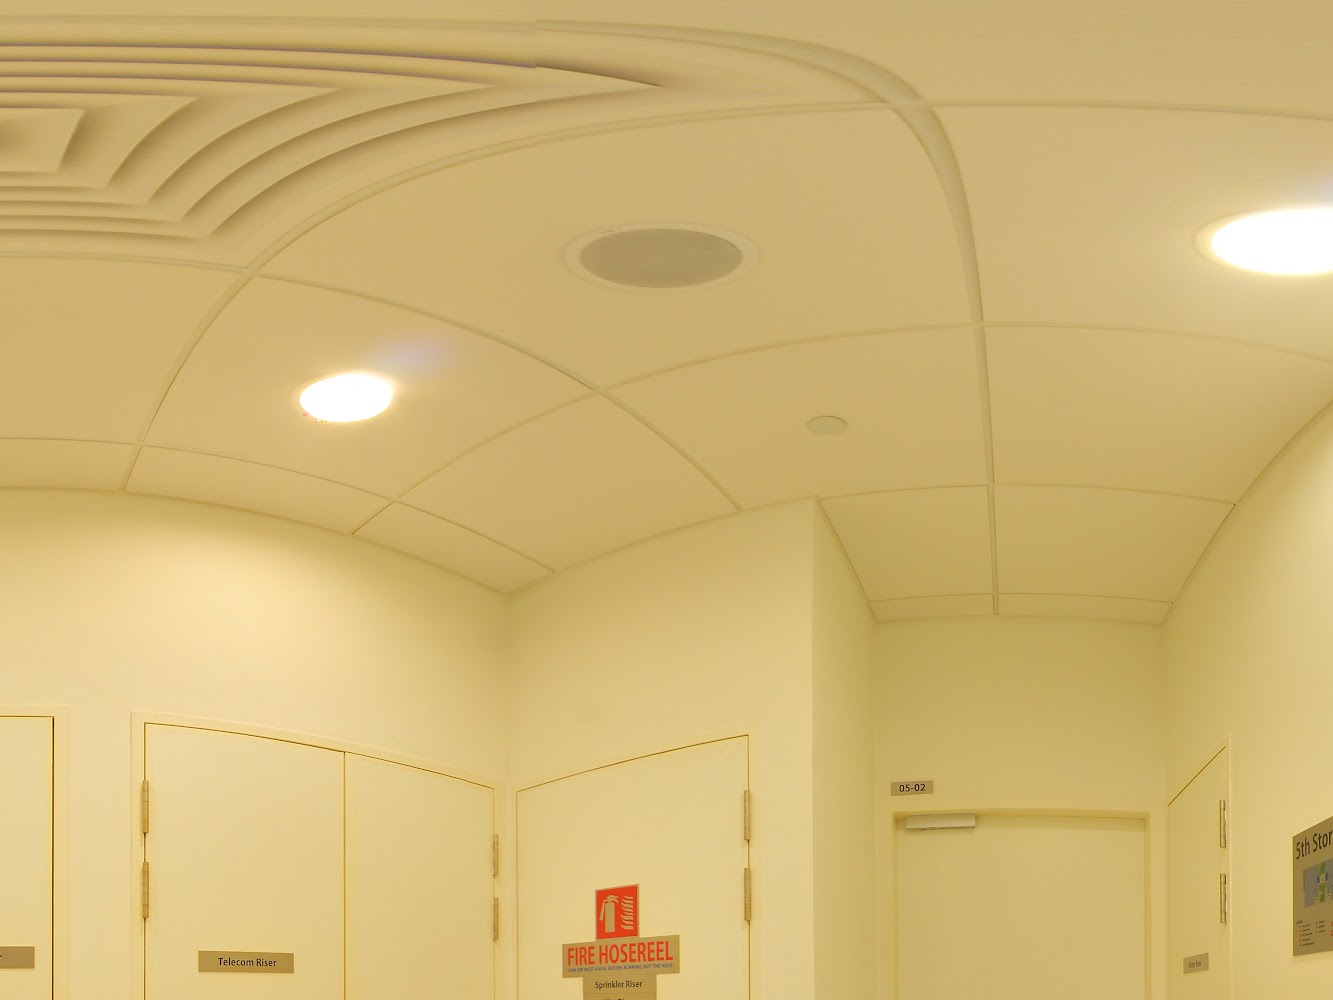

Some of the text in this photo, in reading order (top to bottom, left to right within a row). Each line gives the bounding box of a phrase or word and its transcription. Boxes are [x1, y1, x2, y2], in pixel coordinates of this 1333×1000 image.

[899, 783, 926, 793] 05-02
[1296, 837, 1310, 860] 5th
[567, 941, 673, 966] FIRE HOSEREEL
[218, 957, 277, 967] Telecom Riser
[595, 980, 643, 990] Sprinkler Riser
